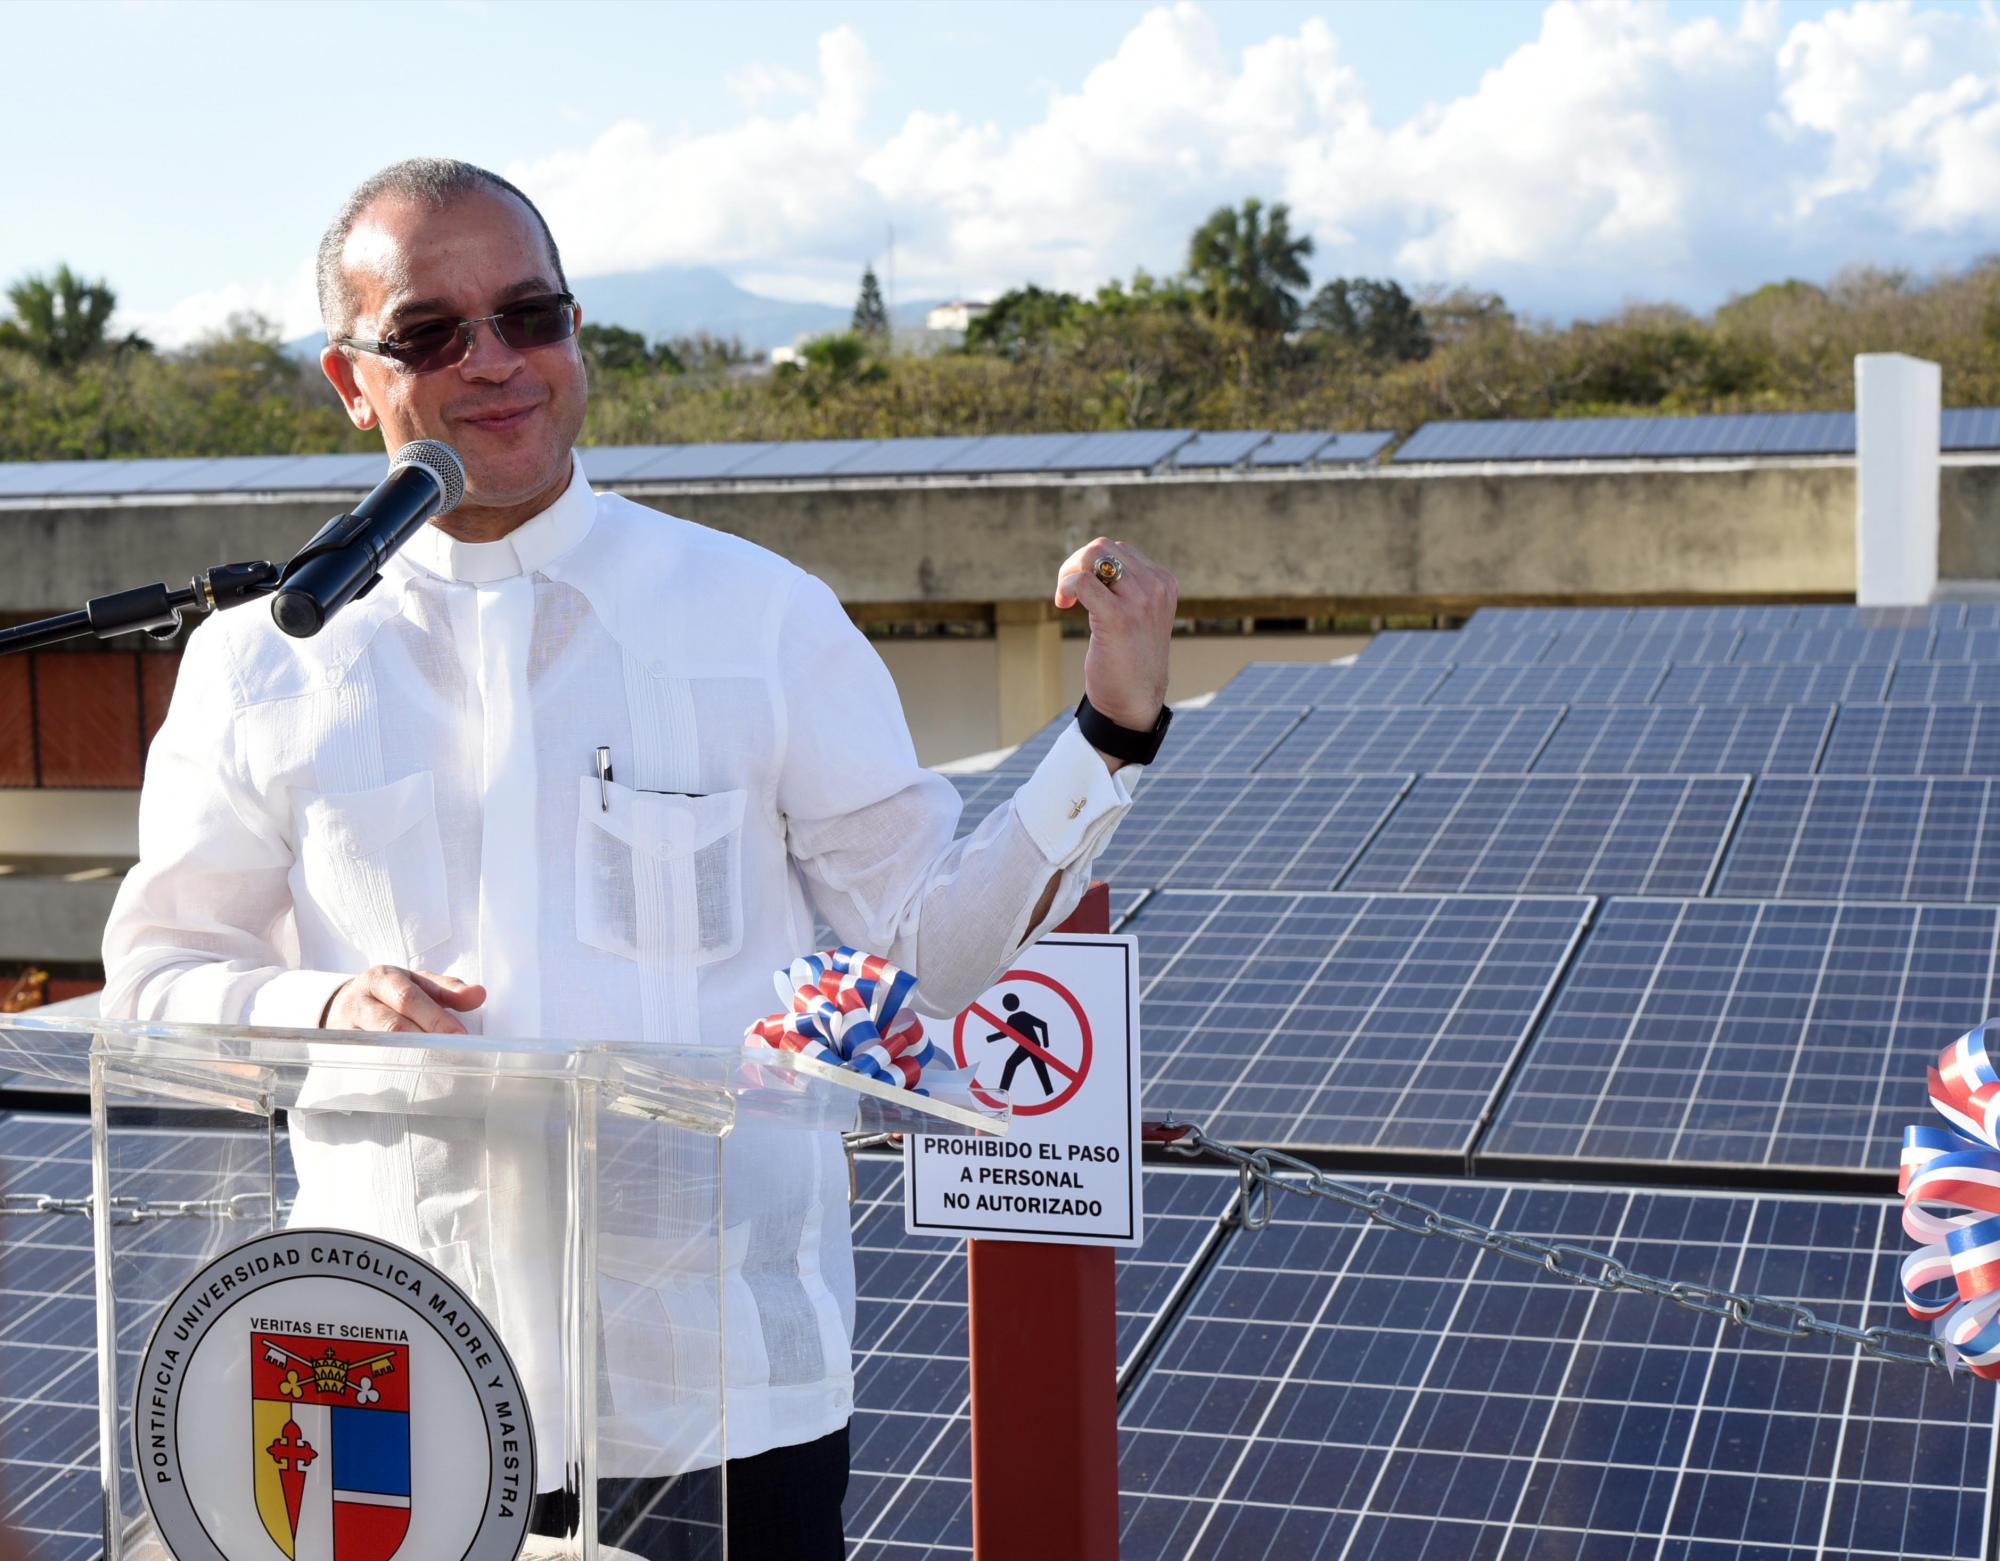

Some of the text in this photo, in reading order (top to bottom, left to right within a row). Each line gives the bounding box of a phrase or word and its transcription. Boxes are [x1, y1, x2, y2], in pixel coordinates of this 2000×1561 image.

[924, 1138, 1120, 1163] PROHIBIDO EL PASO
[960, 1167, 1084, 1188] A PERSONAL
[944, 1193, 1102, 1217] NO AUTORIZADO
[250, 1318, 409, 1342] VERITAS ET SCIENTIA
[151, 1247, 520, 1518] PONTIFICIA UNIVERSIDAD CATÓLICA MADRE Y MAESTRA
